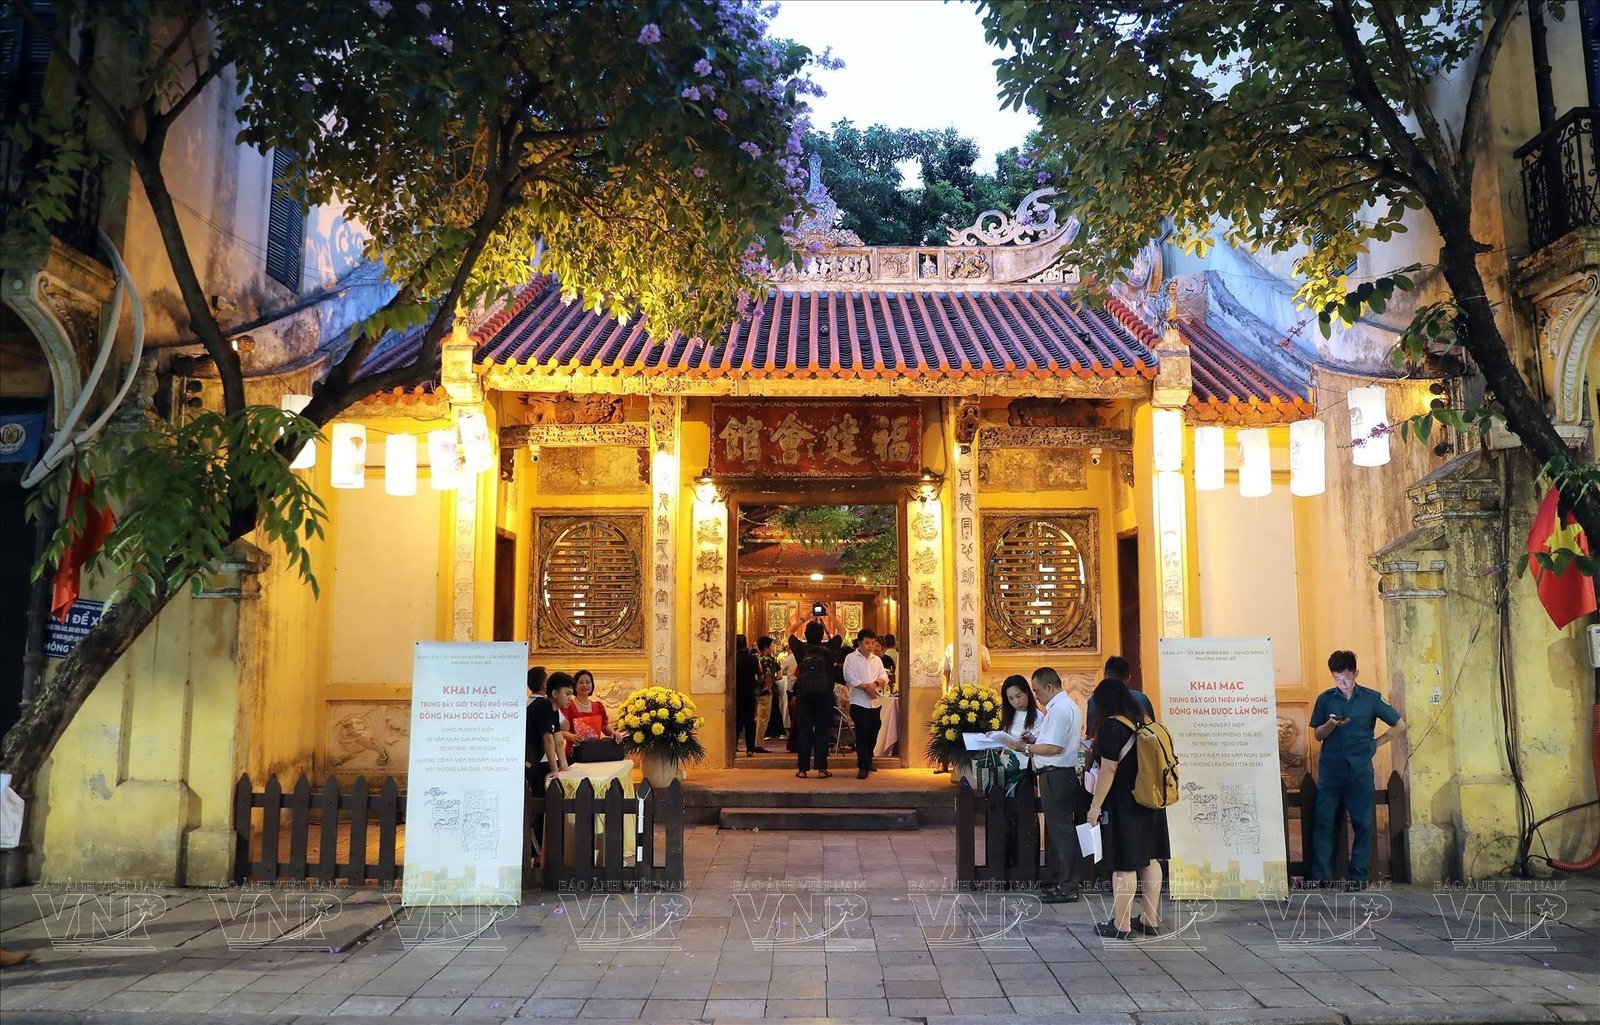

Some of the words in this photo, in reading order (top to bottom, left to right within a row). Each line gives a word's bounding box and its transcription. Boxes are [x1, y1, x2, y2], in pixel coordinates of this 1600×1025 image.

[72, 611, 90, 625] ĐỂ
[91, 616, 100, 627] X
[45, 642, 70, 653] HÔNG
[442, 686, 469, 694] KHAI
[472, 686, 497, 697] MẠC
[1190, 682, 1217, 690] KHAI
[1220, 682, 1244, 692] MẠC
